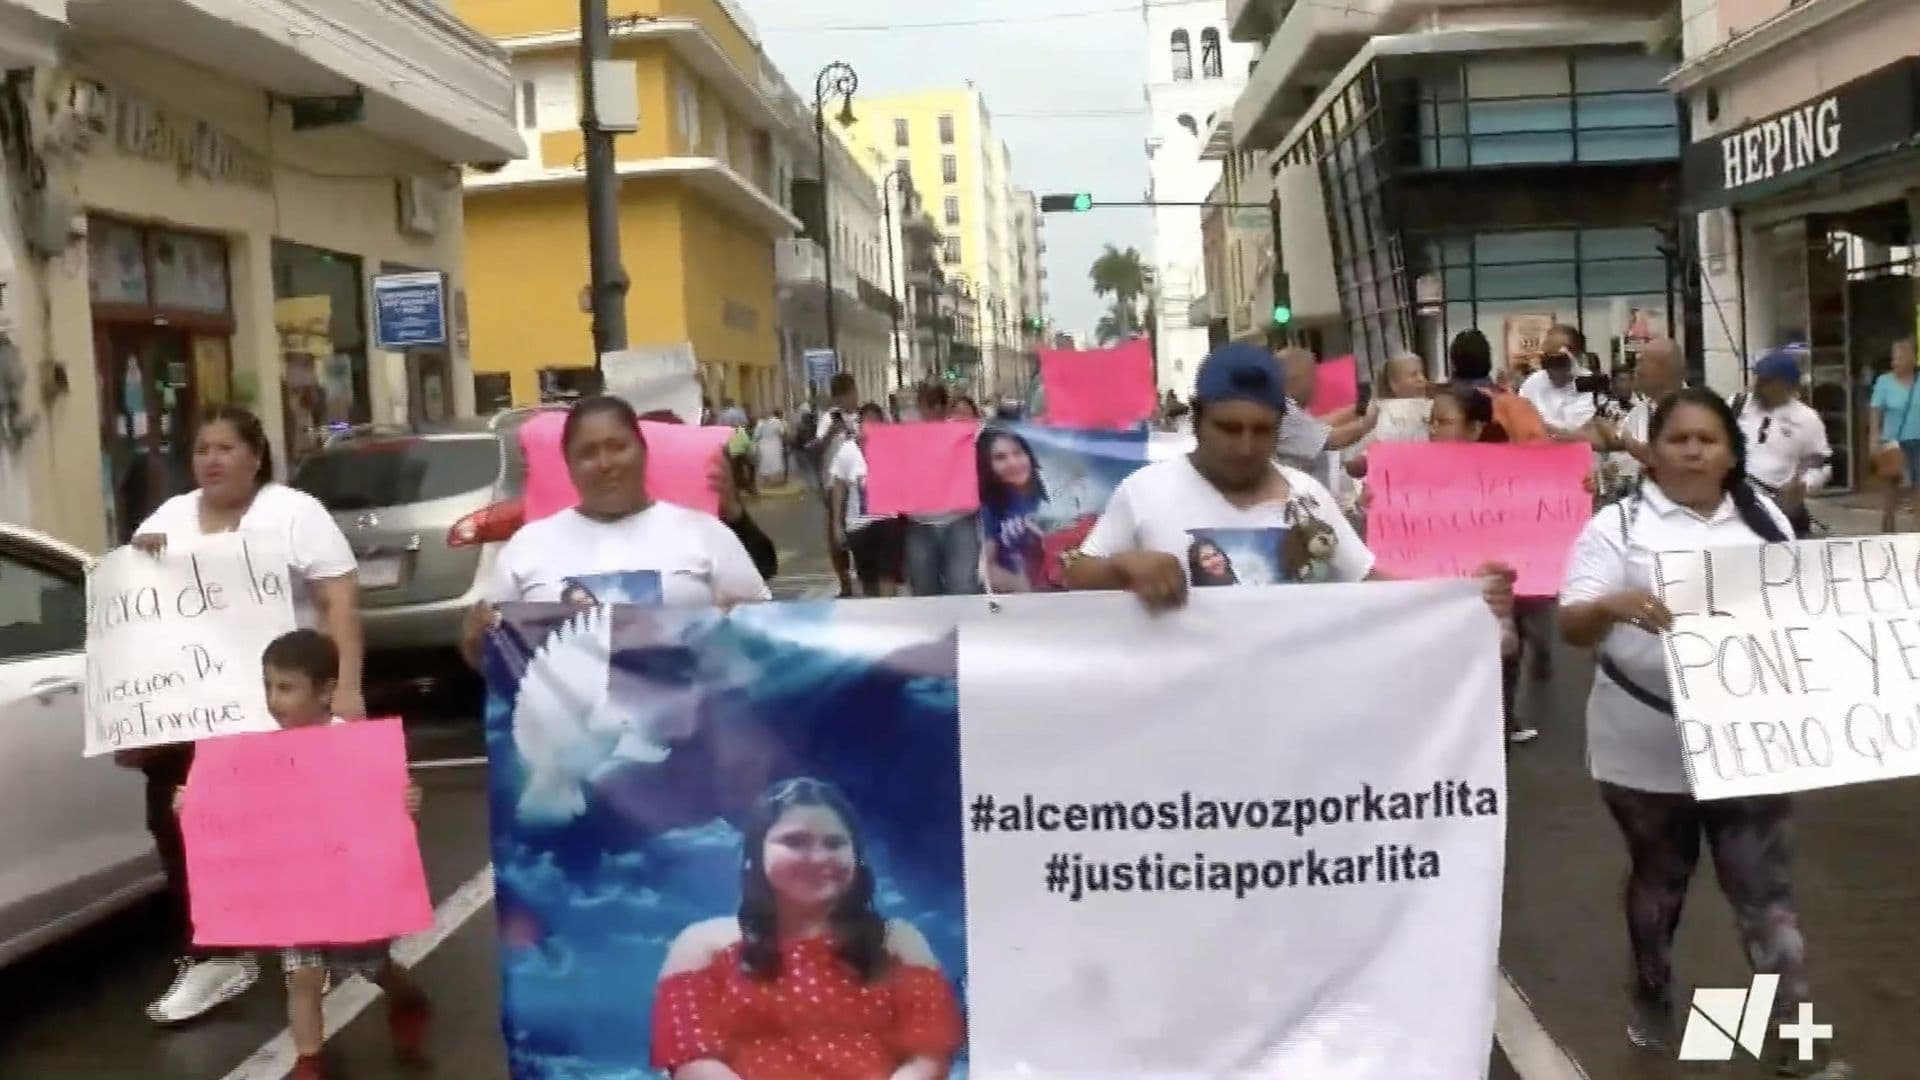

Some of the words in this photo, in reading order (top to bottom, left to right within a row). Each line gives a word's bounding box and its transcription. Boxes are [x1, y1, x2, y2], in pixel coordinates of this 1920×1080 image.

[1722, 96, 1841, 189] HEPING
[177, 552, 229, 618] de
[243, 537, 288, 605] la
[1653, 549, 1735, 618] EL
[1759, 540, 1920, 620] PUEBL
[1666, 630, 1832, 699] PONE
[1678, 715, 1833, 782] PUEBLO
[1846, 702, 1920, 766] QU
[970, 780, 1499, 837] #alcemoslavozporkarlita
[1045, 845, 1441, 901] #justiciaporkarlita
